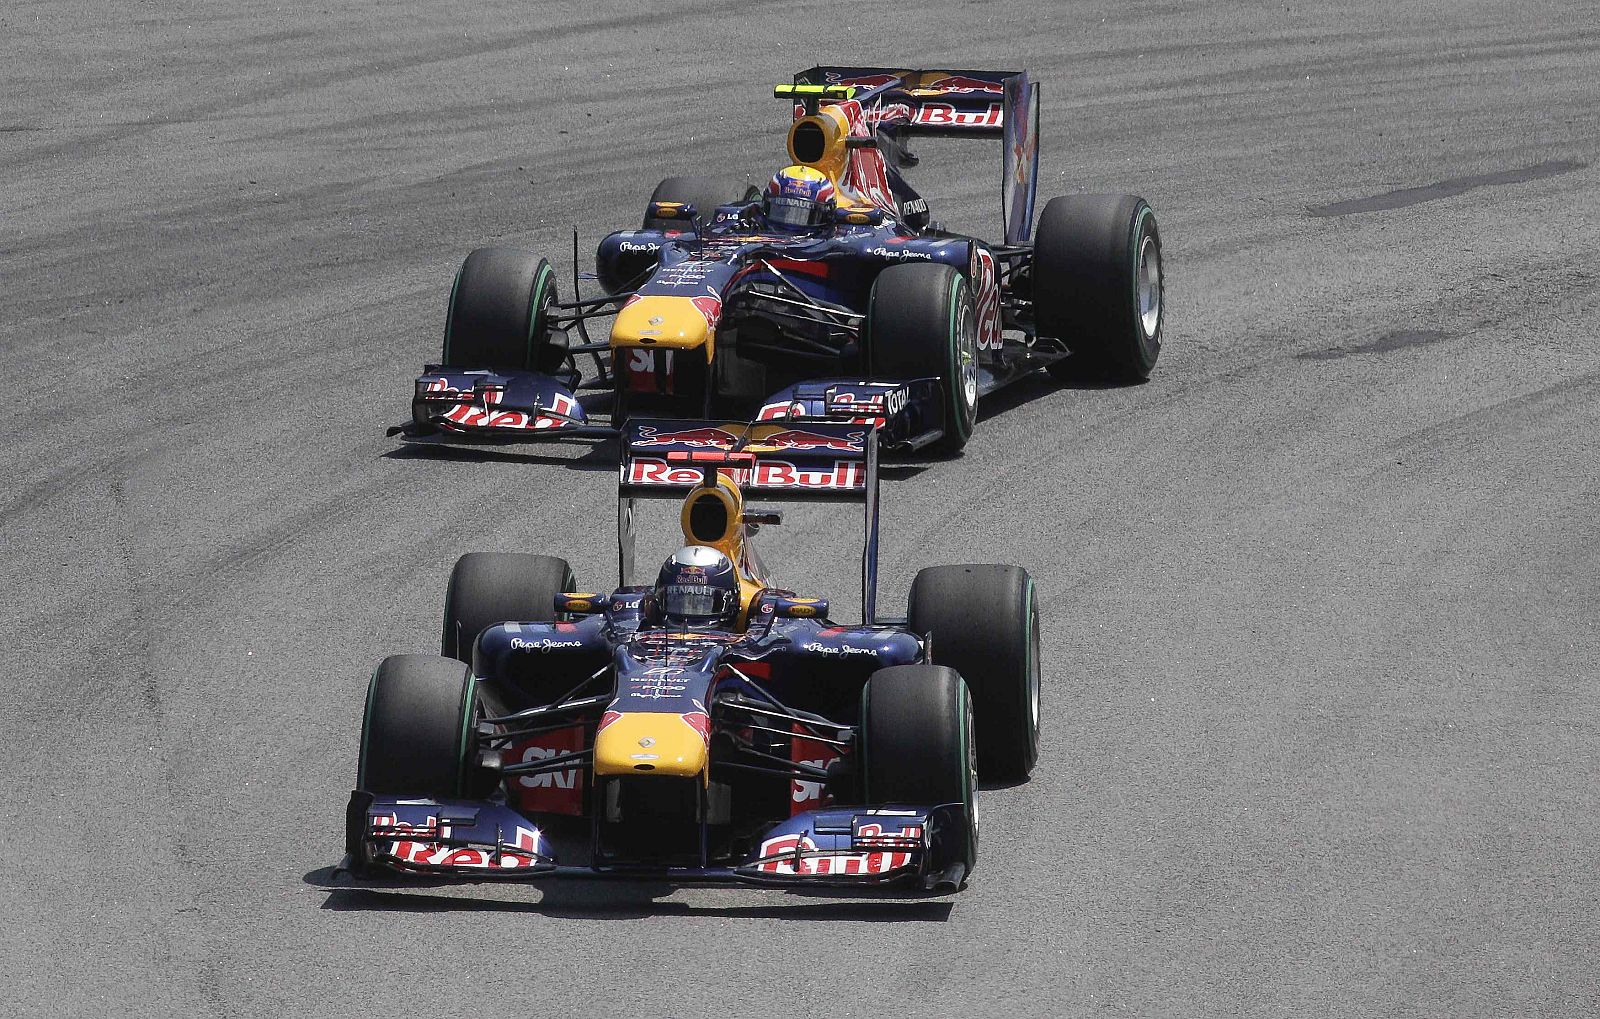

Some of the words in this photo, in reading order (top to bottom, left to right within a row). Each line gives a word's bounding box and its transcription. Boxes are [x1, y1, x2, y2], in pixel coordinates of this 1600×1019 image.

[916, 103, 1003, 127] Bul
[873, 247, 900, 260] Pepe
[902, 250, 932, 260] Jeans
[754, 460, 867, 488] Bull
[667, 585, 715, 595] RENAULT
[625, 601, 639, 609] LG
[510, 637, 541, 653] Pepe
[541, 638, 582, 654] Jeans
[808, 642, 839, 658] Pepe
[839, 645, 878, 658] Jeans
